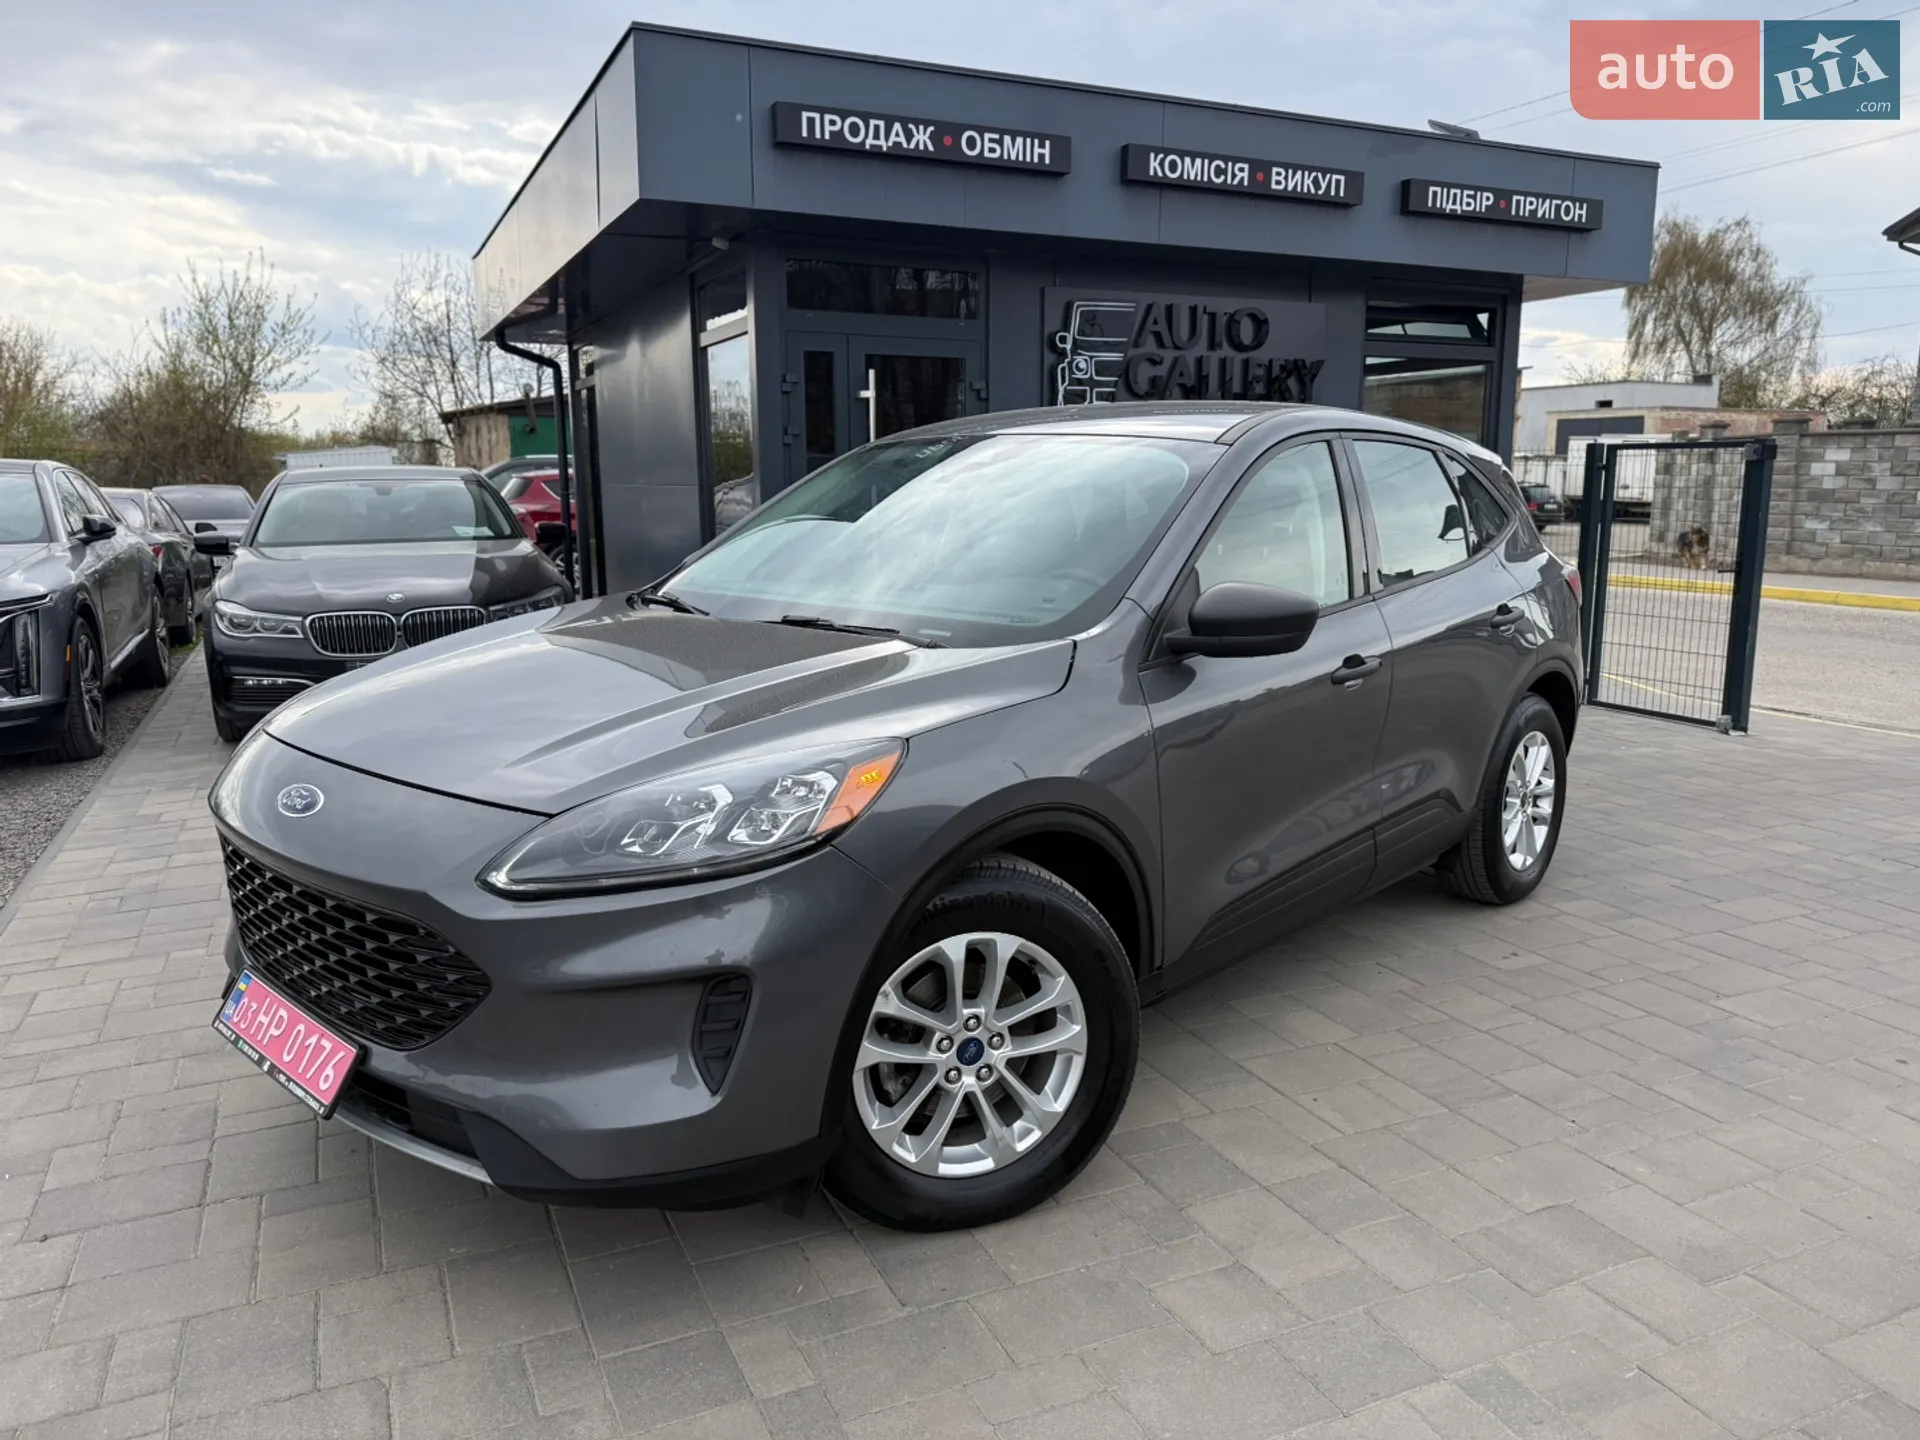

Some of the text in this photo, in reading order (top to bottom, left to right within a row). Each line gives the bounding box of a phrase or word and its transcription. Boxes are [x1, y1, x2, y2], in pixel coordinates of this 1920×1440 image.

[801, 110, 1051, 164] ПРОДАЖ ОБМІН
[1148, 152, 1346, 197] КОМІСІЯ ВИКУП
[1427, 185, 1588, 223] ПІДБІР ПРИГОН
[1132, 301, 1271, 353] AUTO
[1125, 353, 1326, 402] GALLERY
